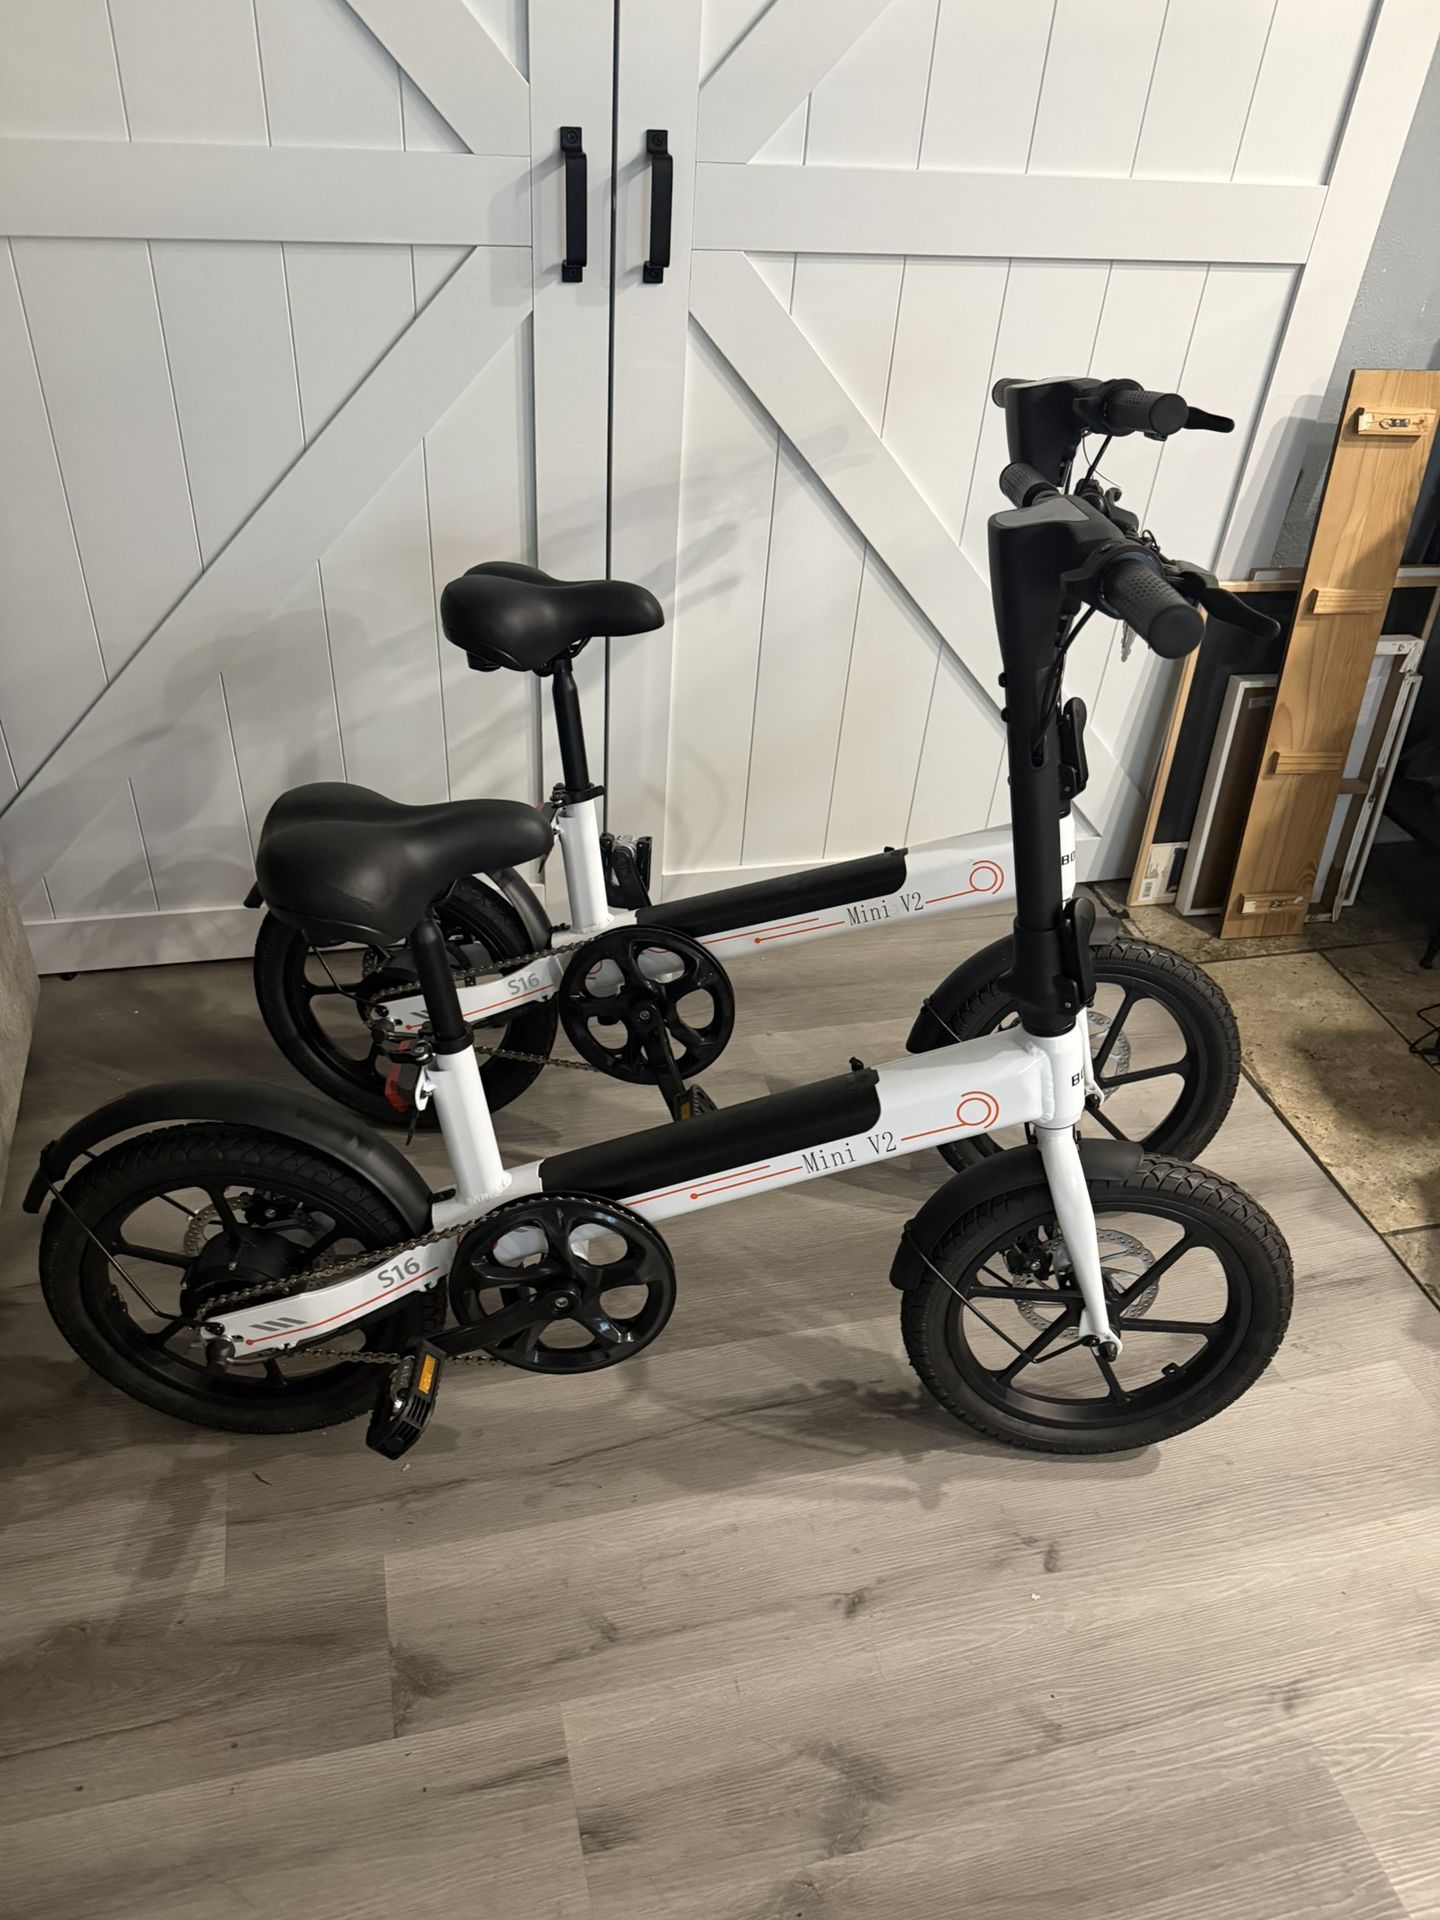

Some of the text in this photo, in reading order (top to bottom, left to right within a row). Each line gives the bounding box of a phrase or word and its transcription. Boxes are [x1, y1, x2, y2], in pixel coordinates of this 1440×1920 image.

[846, 891, 924, 926] Mini V2
[507, 972, 540, 995] S16
[802, 1131, 897, 1174] Mini V2
[377, 1256, 421, 1289] S16
